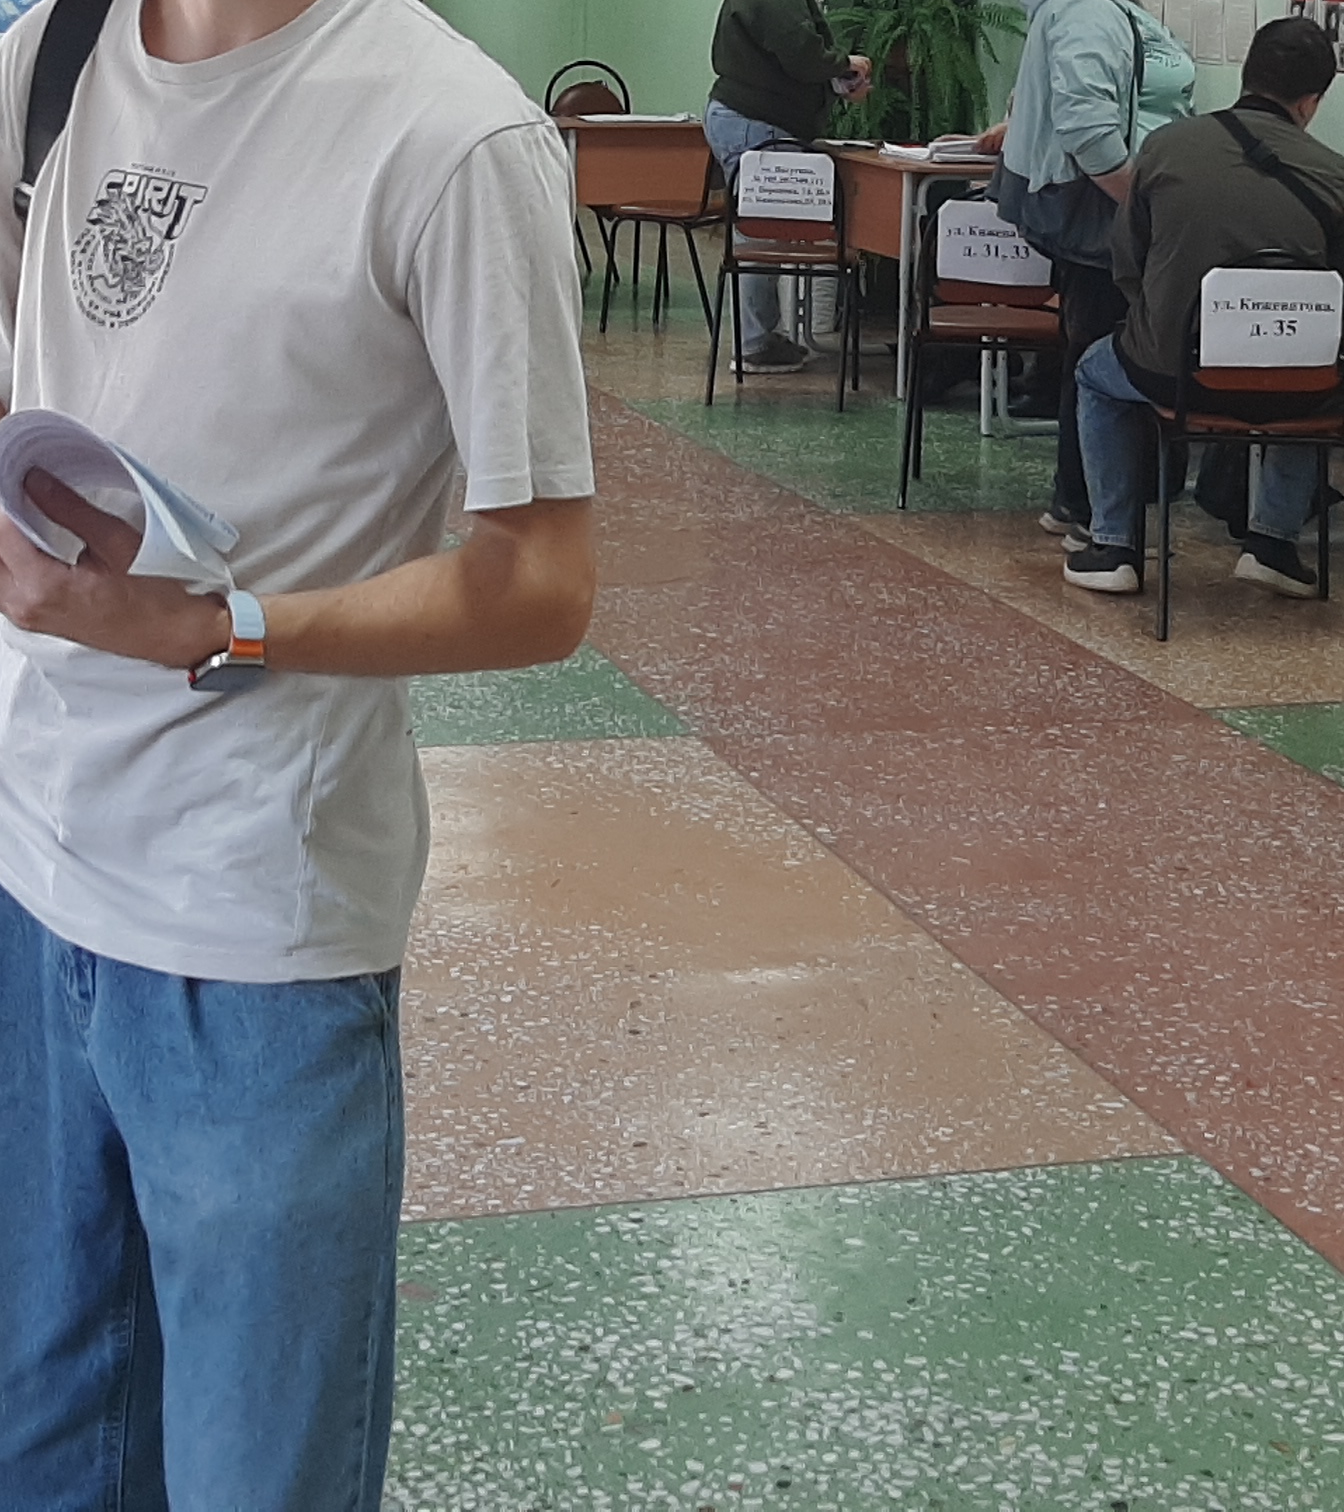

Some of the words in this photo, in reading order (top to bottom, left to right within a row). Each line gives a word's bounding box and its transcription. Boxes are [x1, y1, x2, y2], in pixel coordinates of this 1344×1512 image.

[87, 168, 209, 240] SPIRIT
[1010, 245, 1031, 260] 33
[1212, 300, 1236, 313] ул.
[1249, 322, 1269, 338] д.
[1273, 319, 1298, 337] 35
